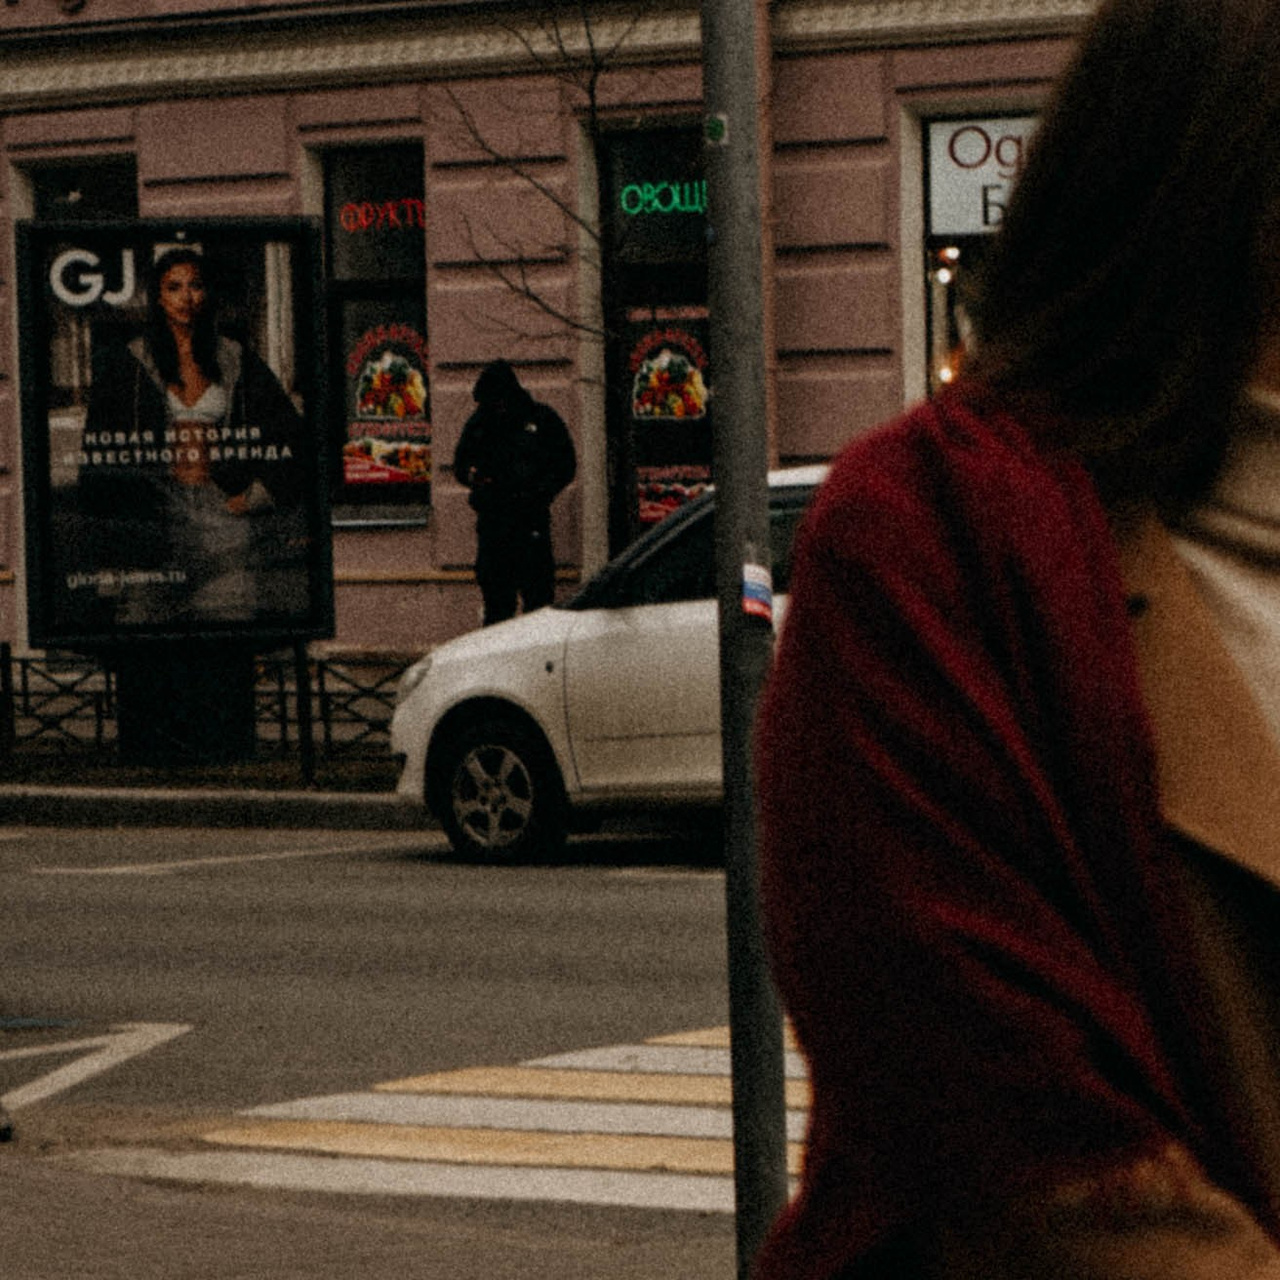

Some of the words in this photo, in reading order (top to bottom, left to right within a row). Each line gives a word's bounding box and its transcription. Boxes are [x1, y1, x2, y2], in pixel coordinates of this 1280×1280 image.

[49, 248, 136, 307] GJ
[84, 429, 155, 446] НОВАЯ
[164, 426, 262, 444] ИСТОРИЯ
[209, 444, 293, 462] БРЕНДА
